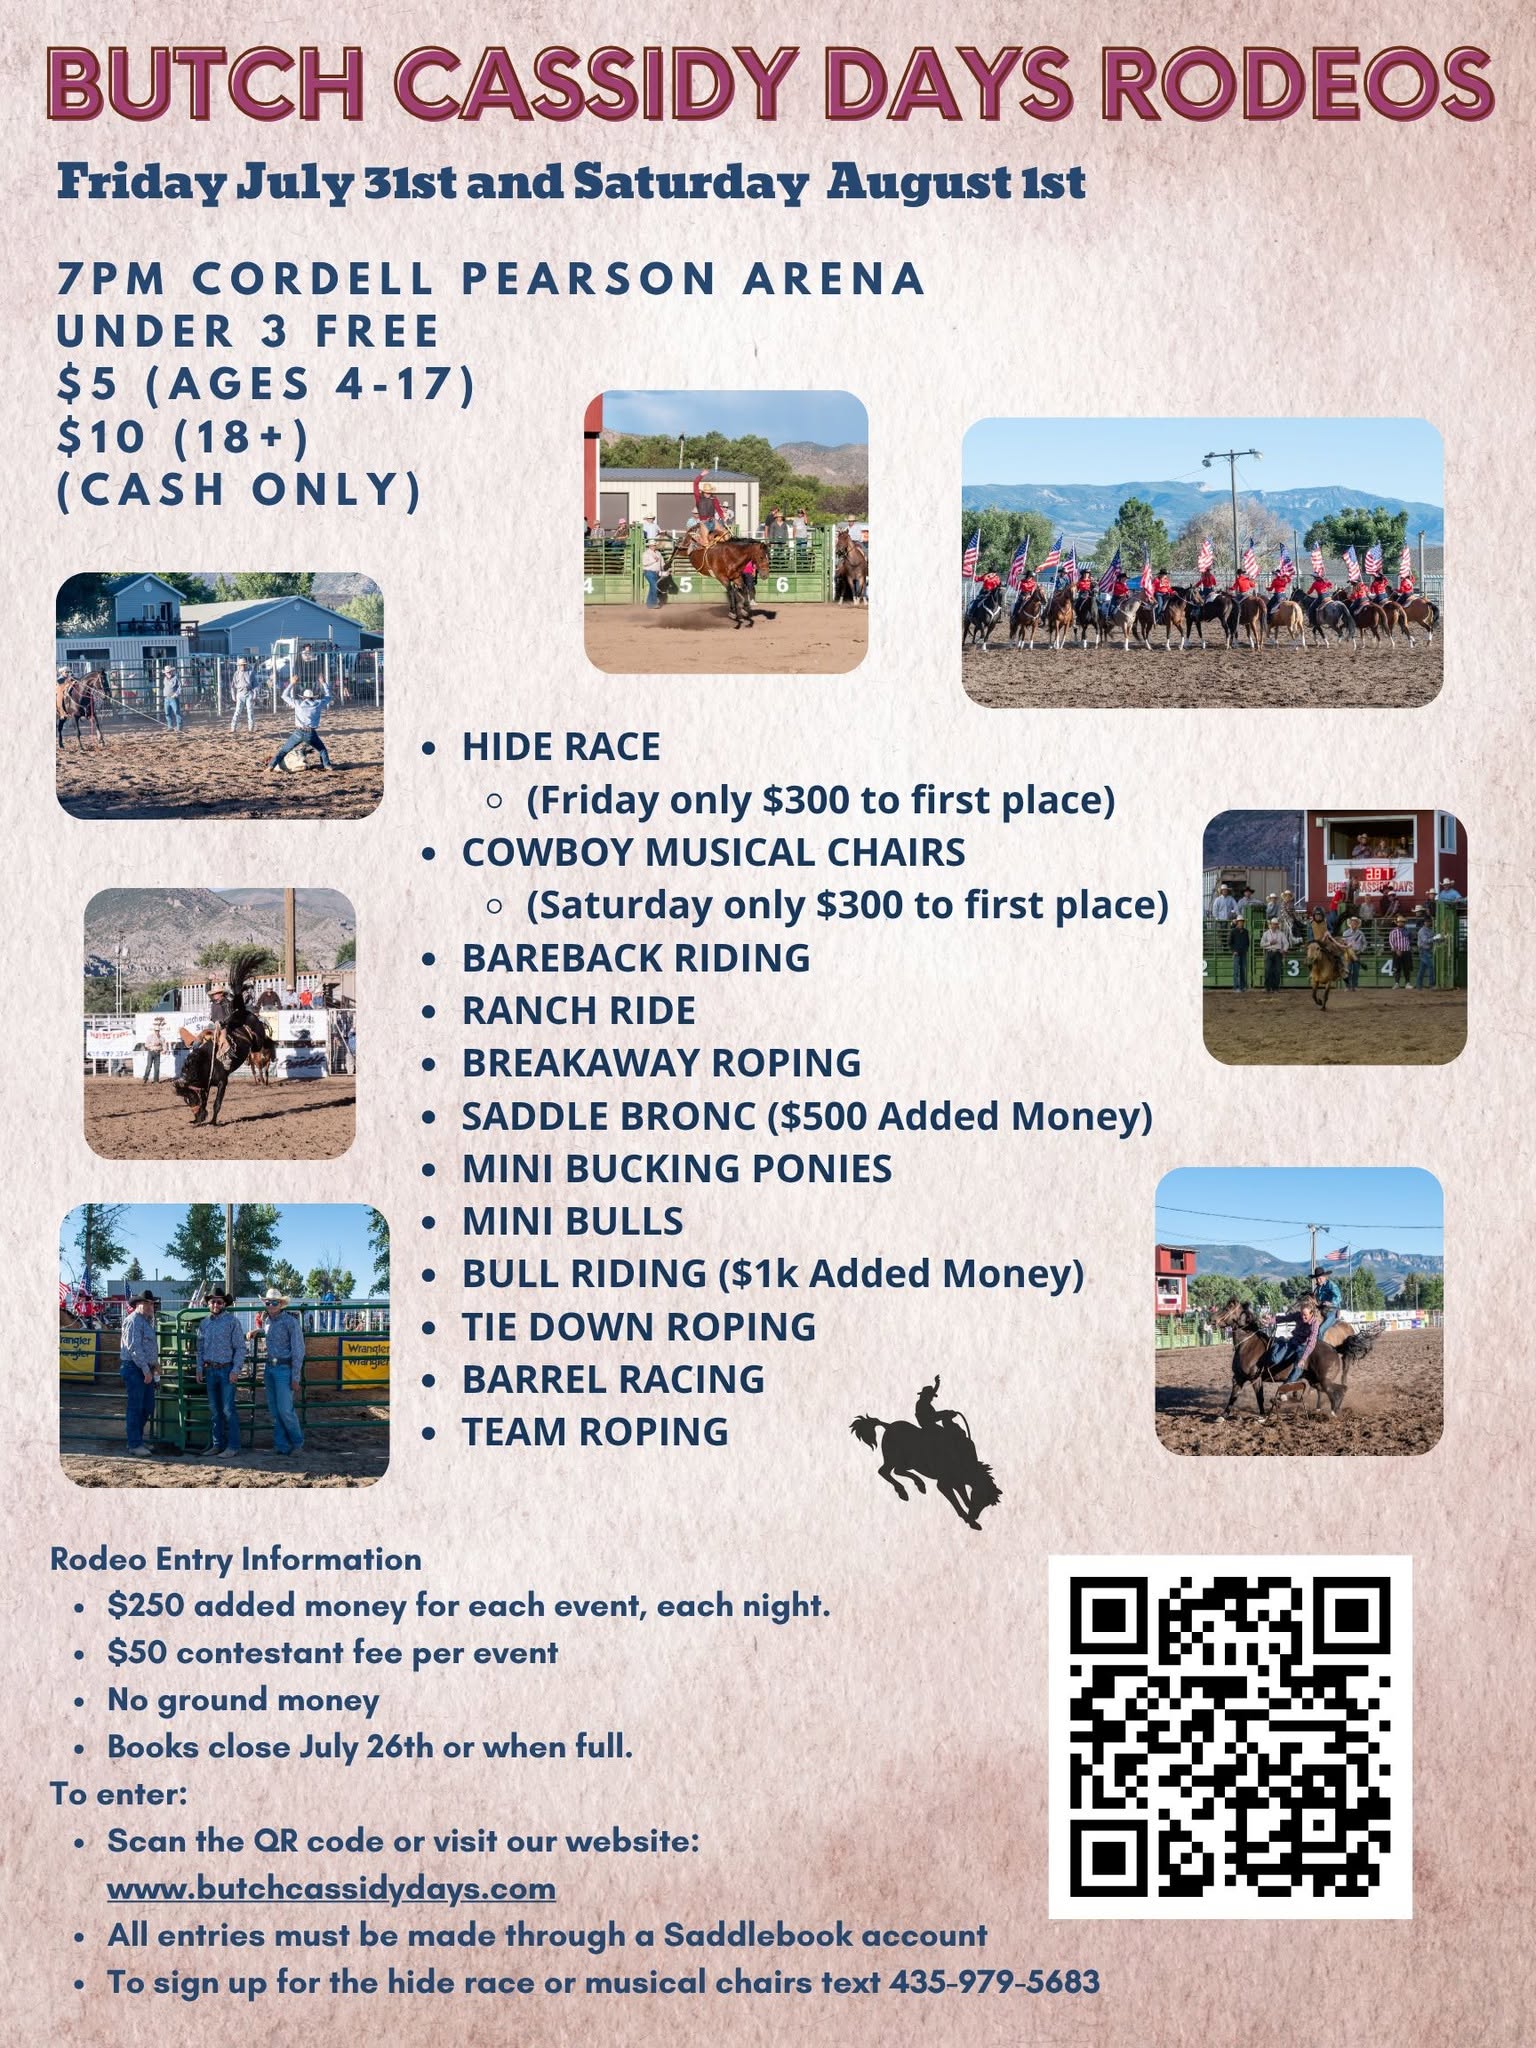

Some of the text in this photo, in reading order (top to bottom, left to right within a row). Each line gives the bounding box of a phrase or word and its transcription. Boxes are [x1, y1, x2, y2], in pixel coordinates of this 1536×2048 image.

[46, 45, 1496, 123] BUTCH CASSIDY DAYS RODEOS
[57, 160, 1086, 208] Friday July 31st and Saturday August 1st
[57, 261, 925, 296] 7PM CORDELL PEARSON ARENA
[57, 313, 437, 348] UNDER 3 FREE
[57, 361, 473, 410] $5 (AGES 4-17)
[57, 414, 307, 463] $10 (18+)
[57, 470, 419, 516] (CASH ONLY)
[680, 577, 693, 594] 5
[776, 577, 790, 594] 6
[464, 731, 660, 761] HIDE RACE
[527, 783, 1115, 823] (Friday only $300 to first place)
[462, 837, 965, 867] COWBOY MUSICAL CHAIRS
[1393, 880, 1414, 893] DAYS
[527, 888, 1169, 928] (Saturday only $300 to first place)
[463, 943, 810, 973] BAREBACK RIDING
[1287, 959, 1300, 977] 3
[1381, 959, 1395, 977] 4
[464, 995, 695, 1025] RANCH RIDE
[463, 1048, 860, 1078] BREAKAWAY ROPING
[462, 1100, 1153, 1140] SADDLE BRONC ($500 Added Money)
[463, 1153, 892, 1184] MINI BUCKING PONIES
[464, 1206, 683, 1236] MINI BULLS
[463, 1257, 1084, 1297] BULL RIDING ($1k Added Money)
[461, 1312, 815, 1342] TIE DOWN ROPING
[464, 1364, 764, 1394] BARREL RACING
[461, 1416, 728, 1447] TEAM ROPING
[51, 1543, 421, 1579] Rodeo Entry Information
[107, 1589, 830, 1625] $250 added money for each event, each night.
[107, 1636, 559, 1673] $50 contestant fee per event
[108, 1684, 380, 1720] No ground money
[108, 1731, 633, 1767] Books close July 26th or when full.
[49, 1781, 187, 1806] To enter:
[107, 1825, 699, 1853] Scan the QR code or visit our website:
[106, 1872, 557, 1908] www.butchcassidydays.com
[107, 1919, 988, 1955] All entries must be made through a Saddlebook account
[106, 1966, 1101, 2002] To sign up for the hide race or musical chairs text 435-979-5683
